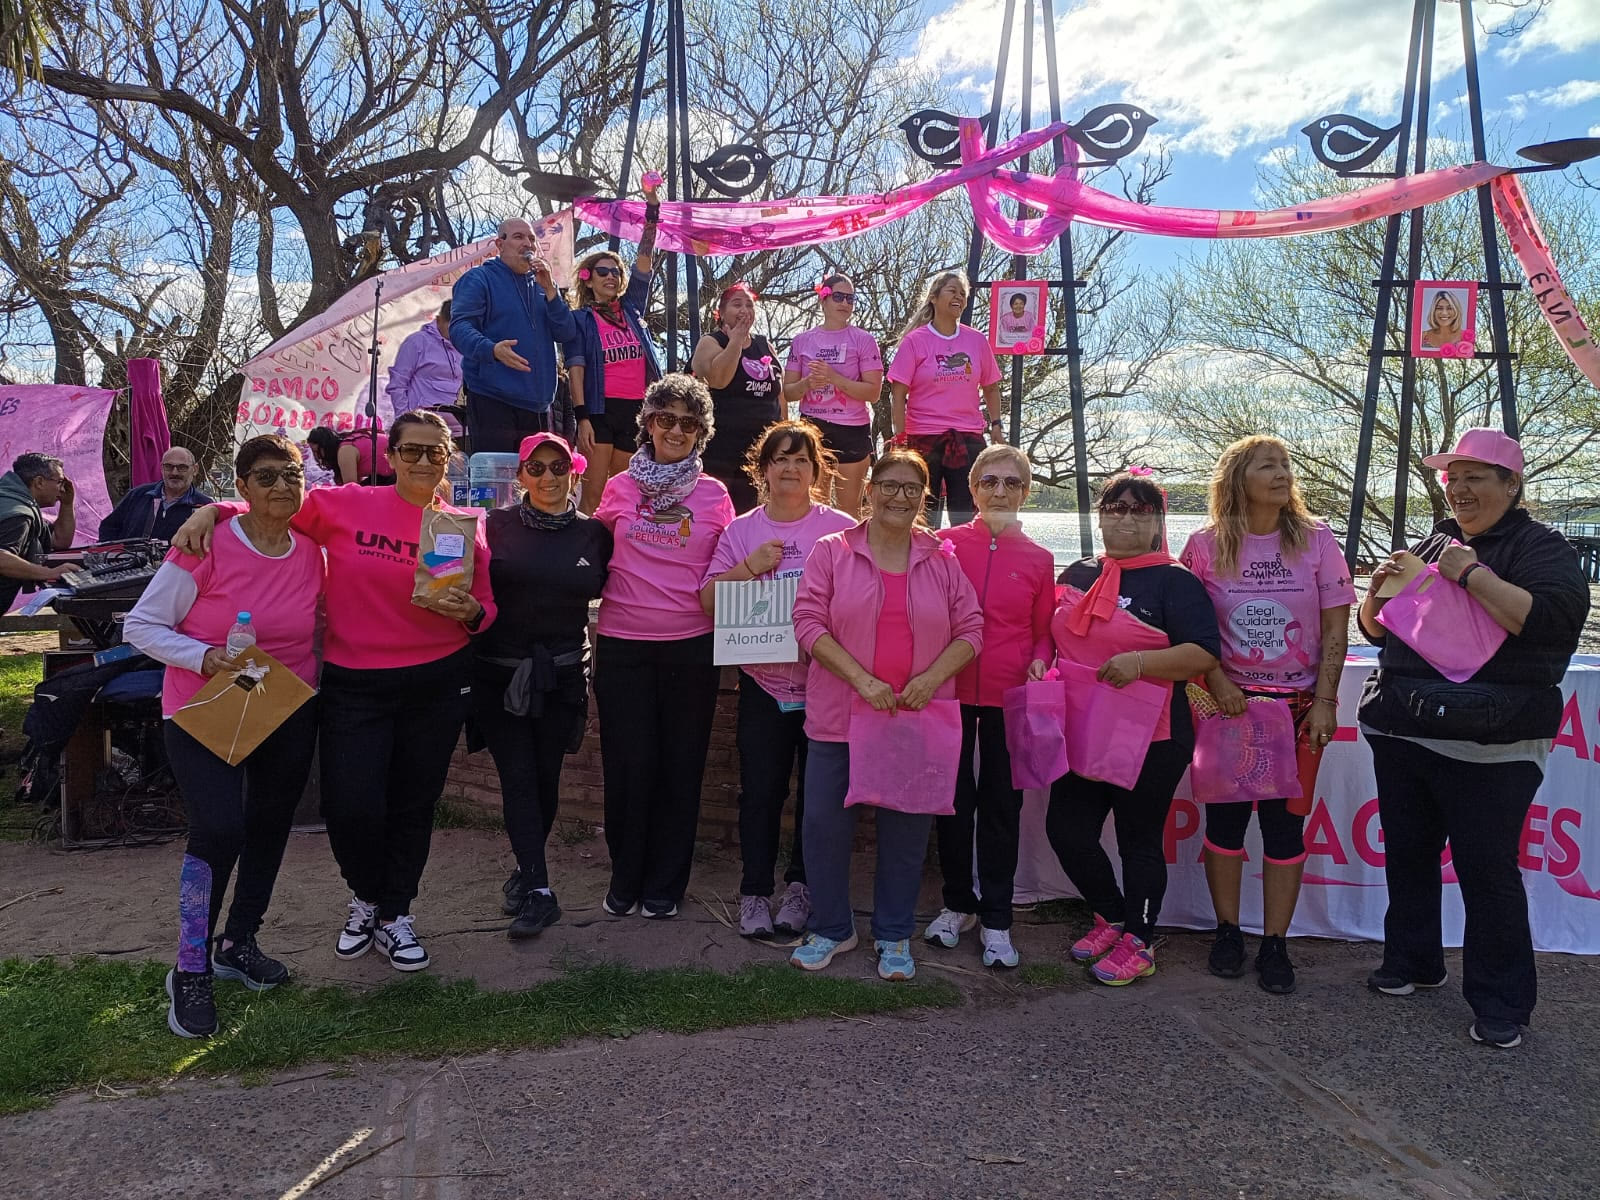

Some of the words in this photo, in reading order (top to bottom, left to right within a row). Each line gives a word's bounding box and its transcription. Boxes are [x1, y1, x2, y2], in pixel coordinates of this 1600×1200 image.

[605, 328, 640, 347] LOV
[746, 381, 772, 392] ZUMBA
[629, 524, 677, 537] SOLIDARIO
[635, 532, 680, 546] PELUCAS
[358, 549, 415, 566] UNTITLED
[1243, 567, 1293, 580] CAMINATA
[1236, 616, 1286, 626] cuidarte
[725, 631, 785, 645] Alondra
[1240, 639, 1284, 648] prevenir
[1245, 671, 1274, 681] 2026
